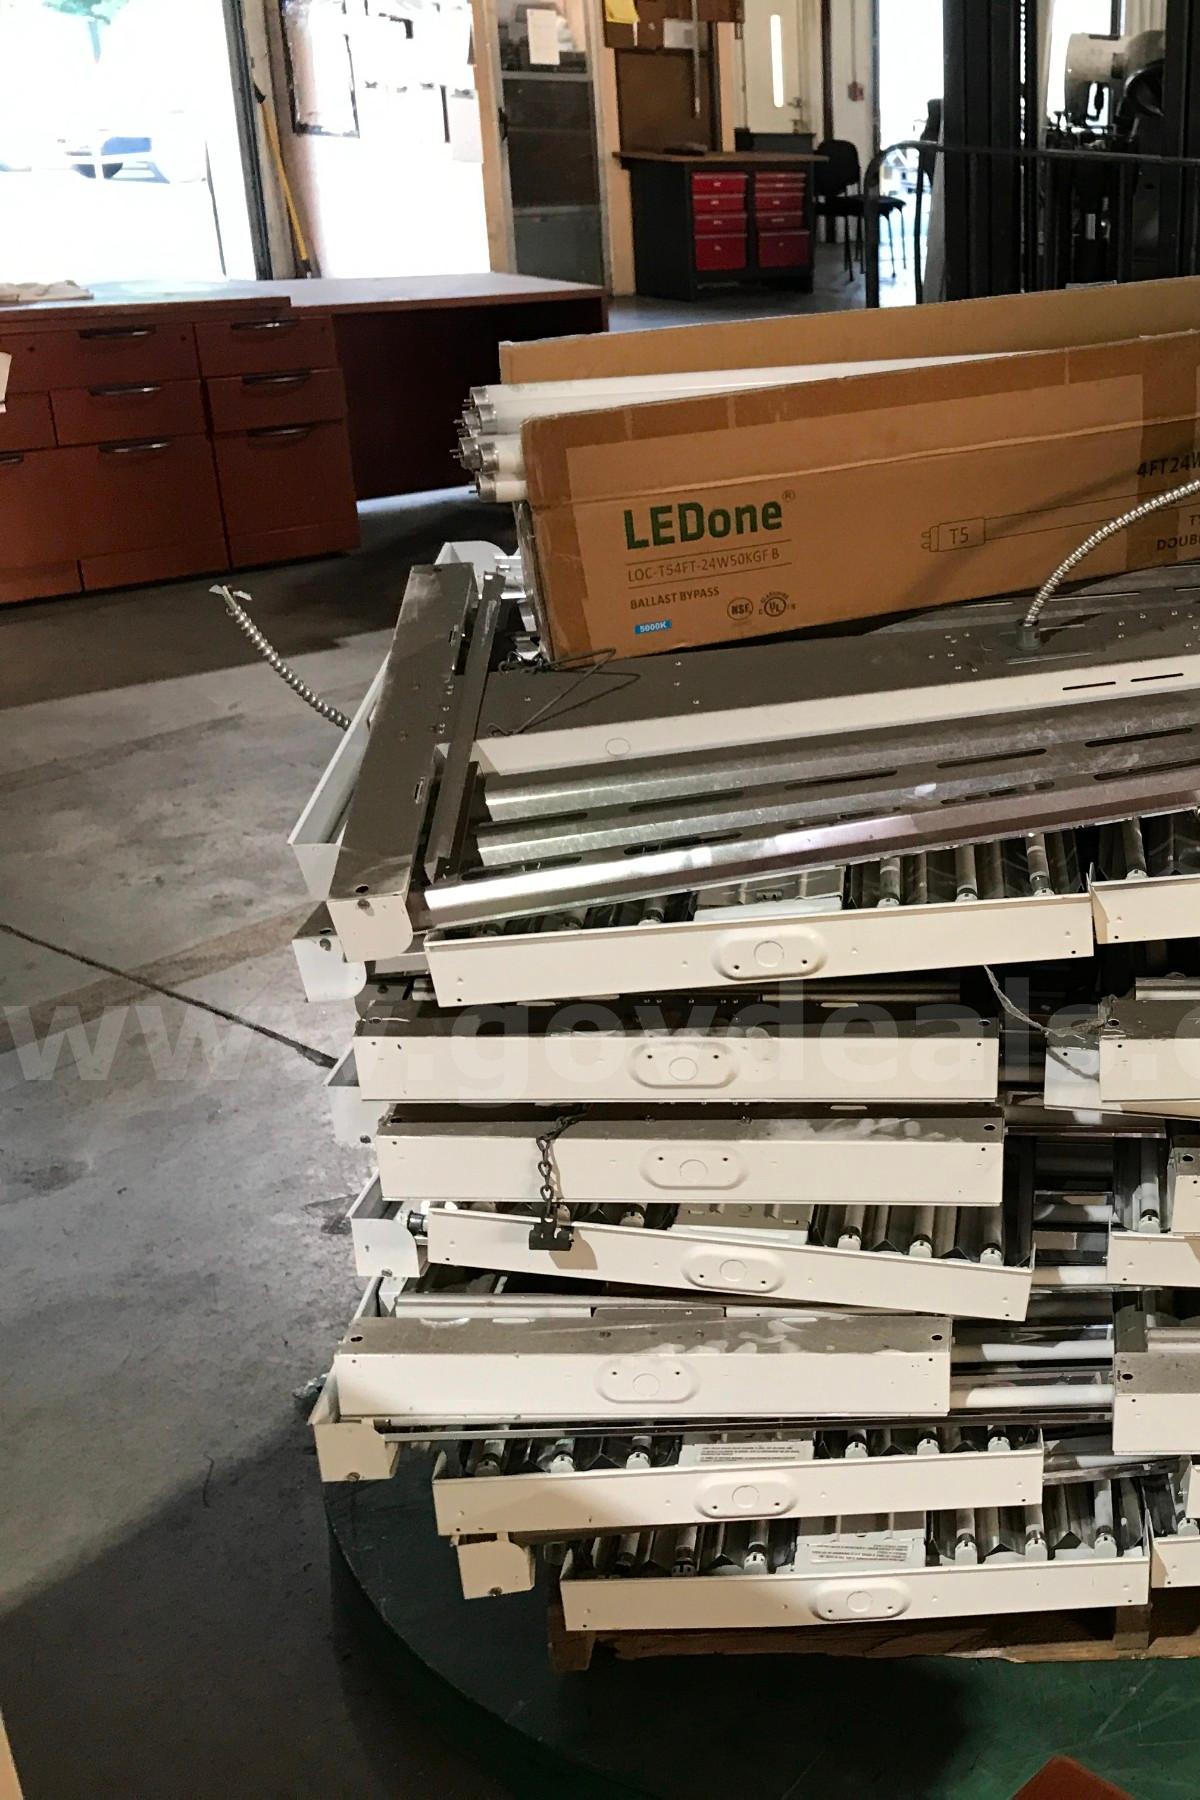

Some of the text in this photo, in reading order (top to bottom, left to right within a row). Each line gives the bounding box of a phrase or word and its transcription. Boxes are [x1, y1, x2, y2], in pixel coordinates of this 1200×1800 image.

[1136, 458, 1168, 478] 4FT
[624, 500, 783, 550] LEDone
[949, 527, 968, 544] T5
[630, 586, 720, 610] BALLAST BYPASS
[639, 620, 668, 633] 5000K
